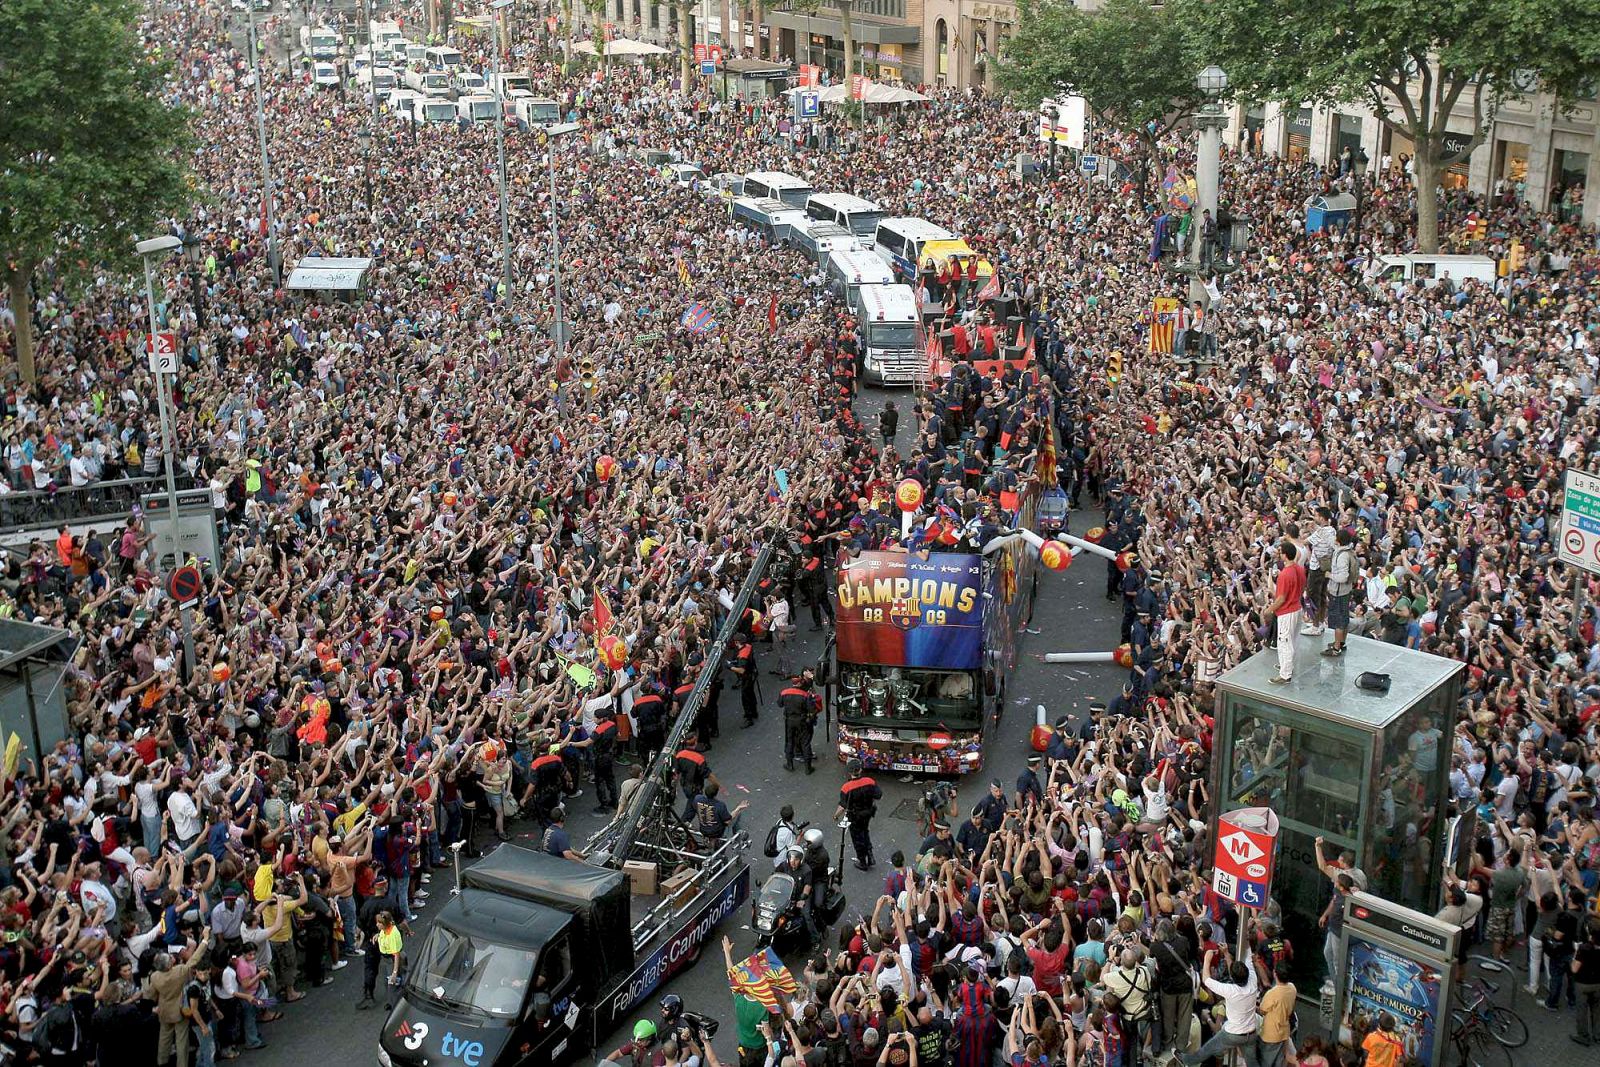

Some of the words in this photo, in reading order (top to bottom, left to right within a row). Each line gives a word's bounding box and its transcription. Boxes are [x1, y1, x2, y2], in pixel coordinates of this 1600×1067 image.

[1575, 476, 1584, 488] La
[1589, 481, 1600, 493] Ra
[838, 577, 977, 613] CAMPIONS
[863, 607, 883, 622] 08
[926, 609, 946, 625] 09
[1231, 837, 1250, 858] M
[1281, 847, 1312, 864] FGC
[1402, 925, 1441, 945] Catalunya
[612, 954, 668, 1021] Felicitats
[669, 884, 738, 963] Campions!
[552, 996, 569, 1017] tve
[1354, 984, 1383, 1002] NOCHE
[1389, 1000, 1417, 1017] MUSEO
[1416, 1009, 1423, 1020] 2
[403, 1022, 429, 1050] 3
[441, 1031, 484, 1066] tve
